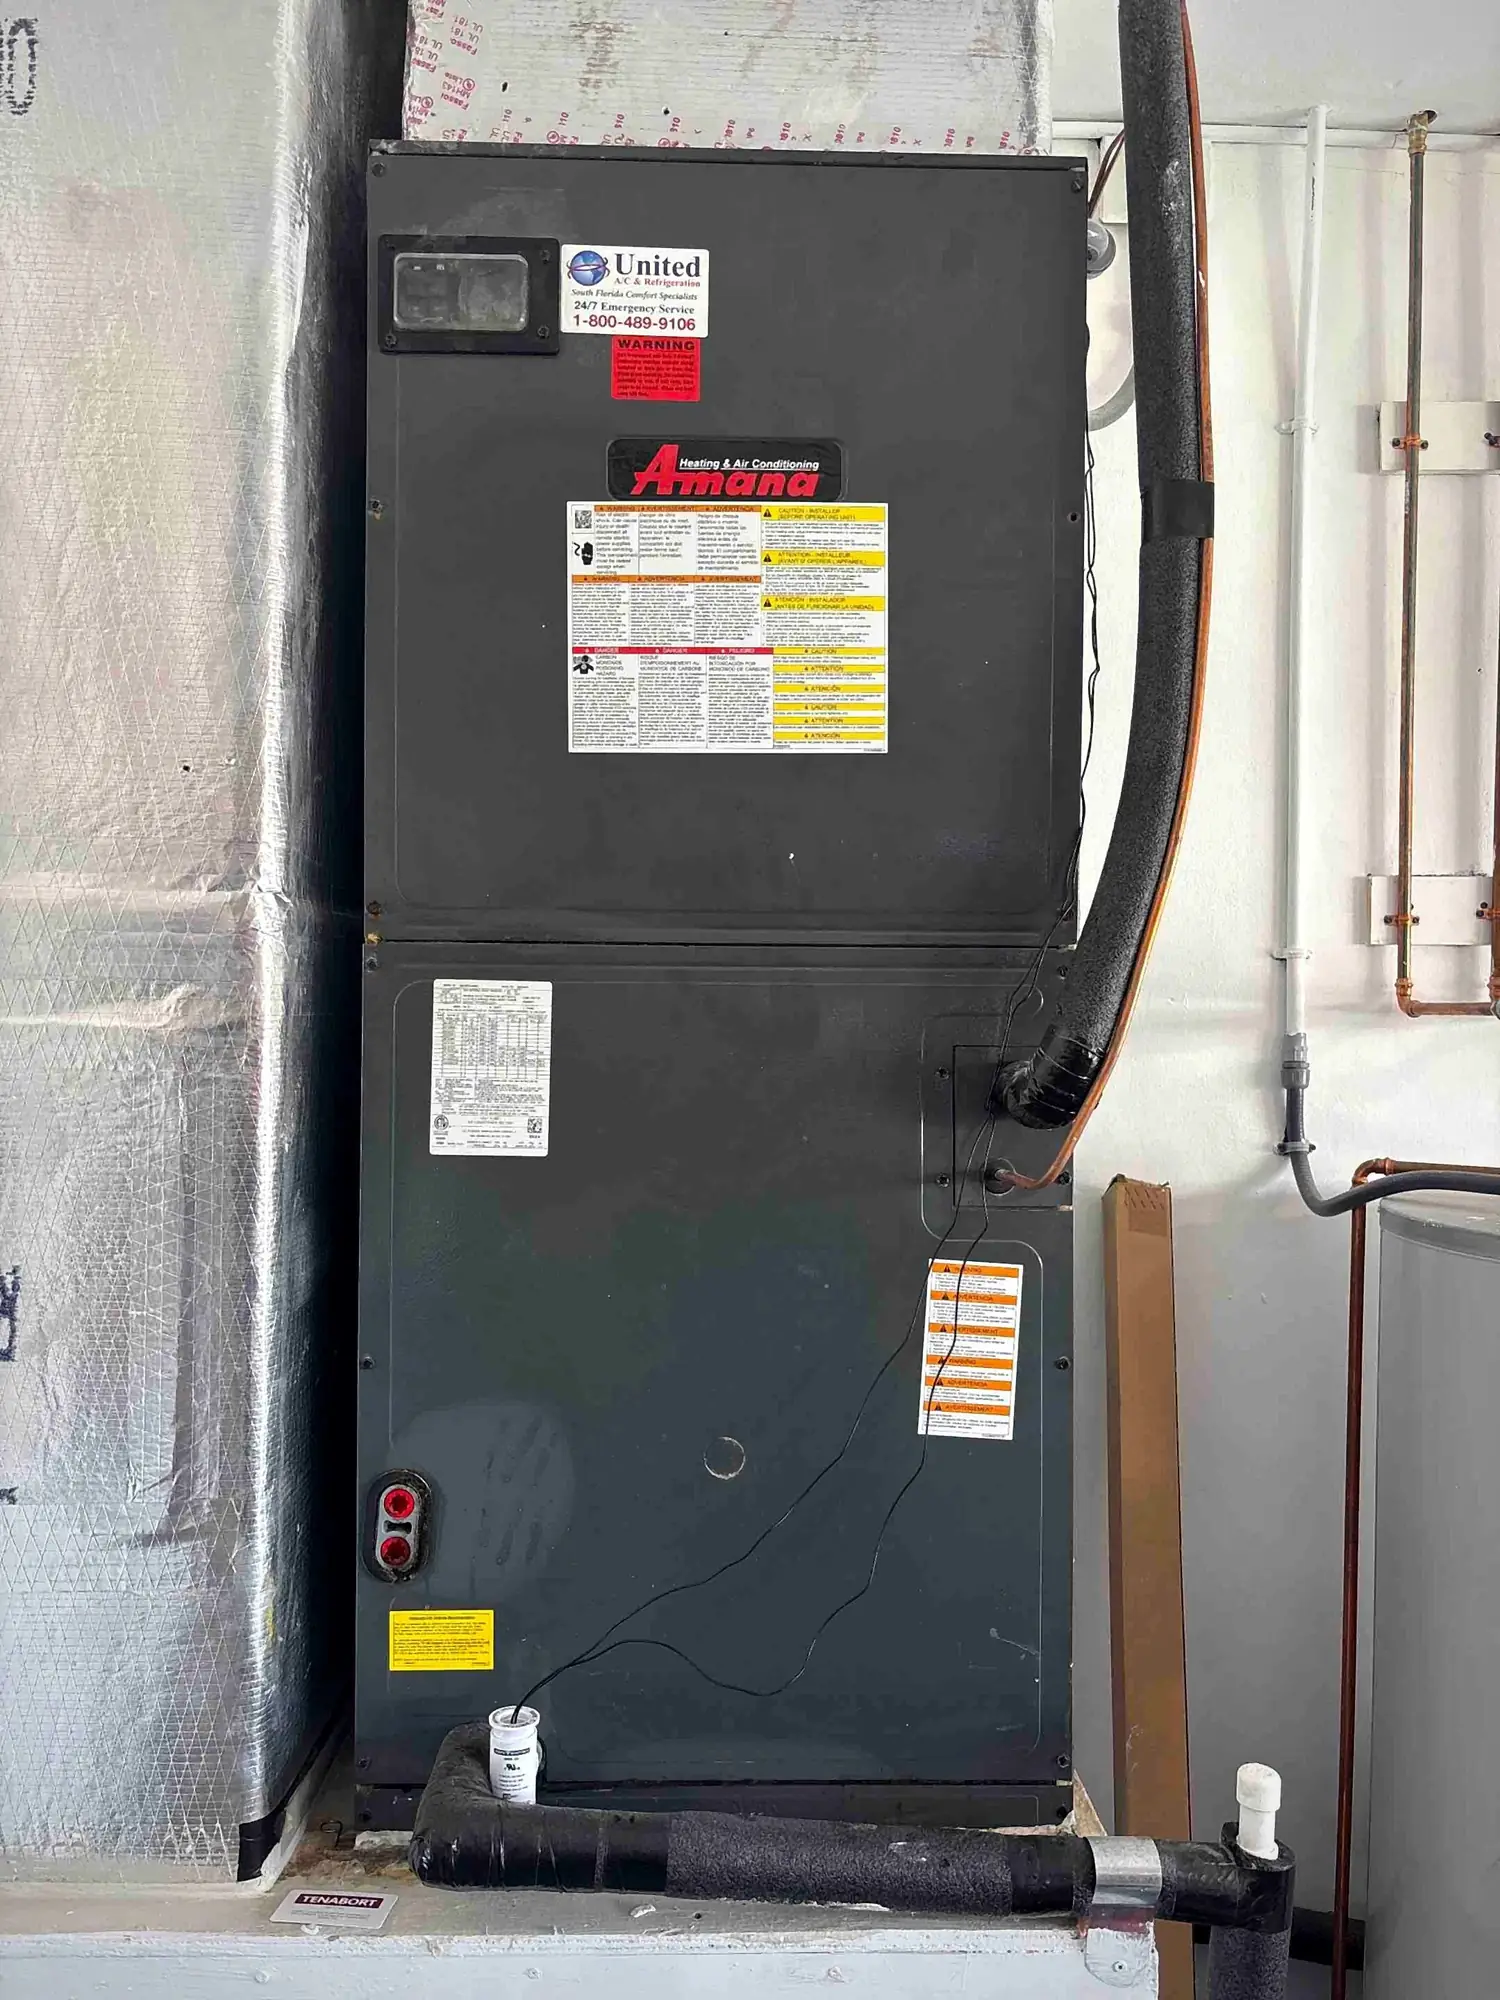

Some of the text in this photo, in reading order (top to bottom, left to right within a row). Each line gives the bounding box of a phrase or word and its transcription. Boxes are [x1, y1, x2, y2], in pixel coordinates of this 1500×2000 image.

[614, 253, 701, 277] United
[614, 277, 701, 289] A/C & Refrigeration
[571, 288, 698, 301] South Florida Comfort Specialists
[574, 300, 695, 315] 24/7 Emergency Service
[573, 314, 696, 332] 1-800-489-9106
[618, 339, 695, 351] WARNING
[630, 443, 820, 497] Amana
[679, 457, 819, 472] Heating & Air Conditioning
[302, 1895, 378, 1907] TENABORT
